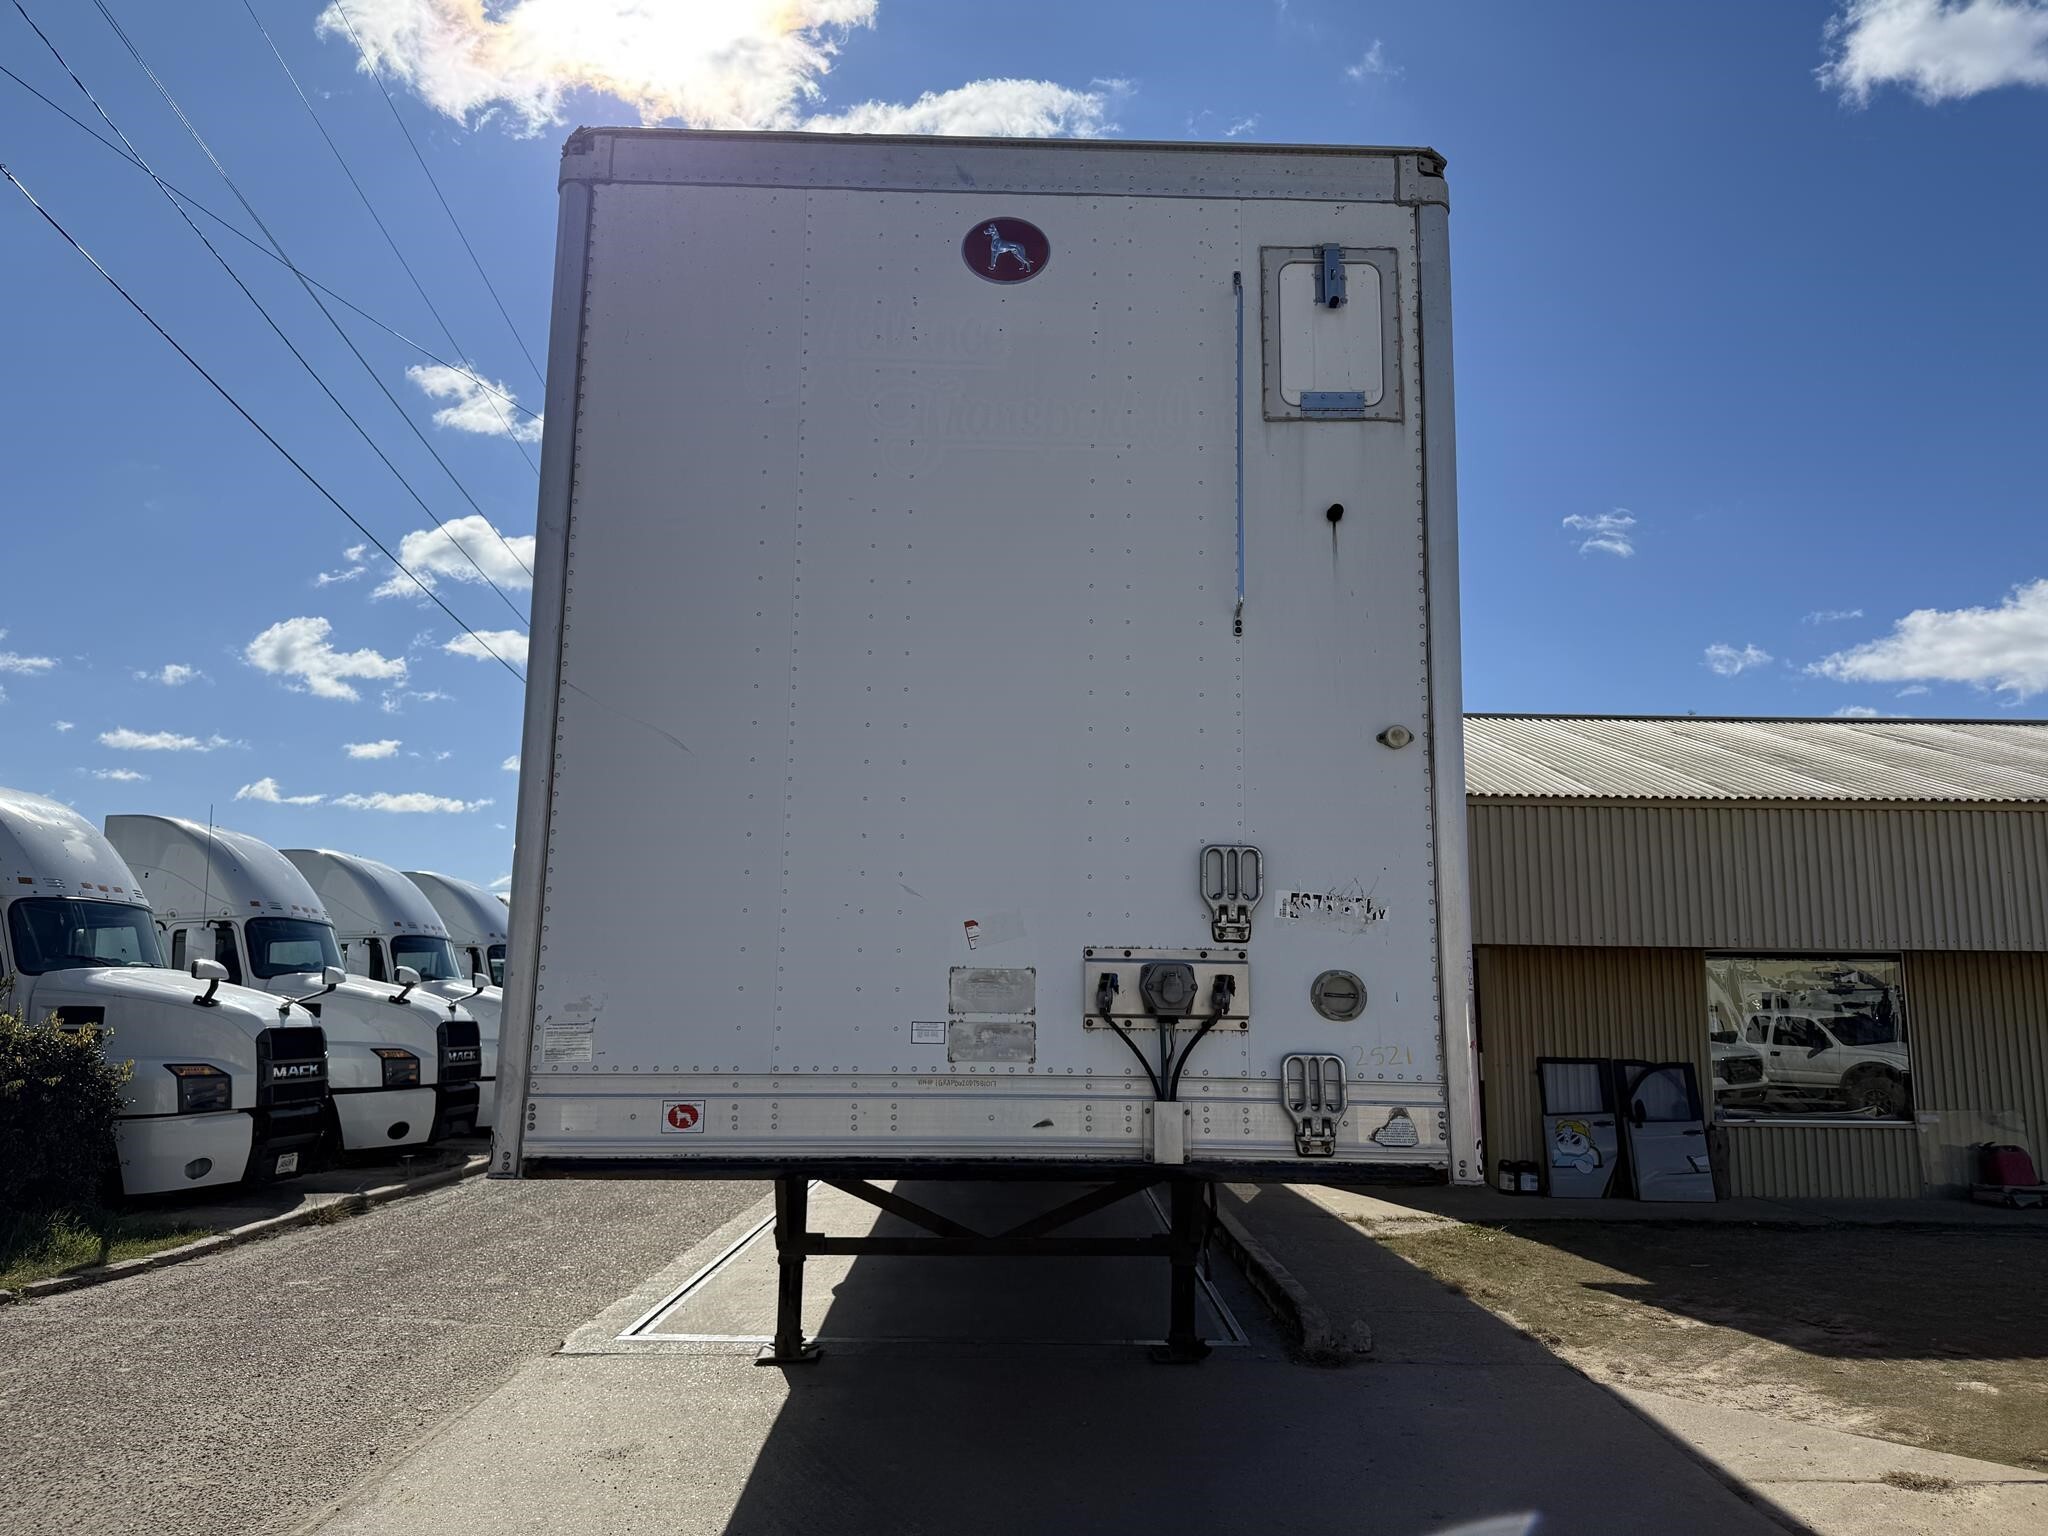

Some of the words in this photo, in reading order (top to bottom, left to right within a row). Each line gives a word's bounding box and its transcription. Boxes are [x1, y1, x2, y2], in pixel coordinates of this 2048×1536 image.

[448, 1051, 476, 1061] MACK
[1351, 1045, 1412, 1066] 2521
[273, 1064, 319, 1077] MACK
